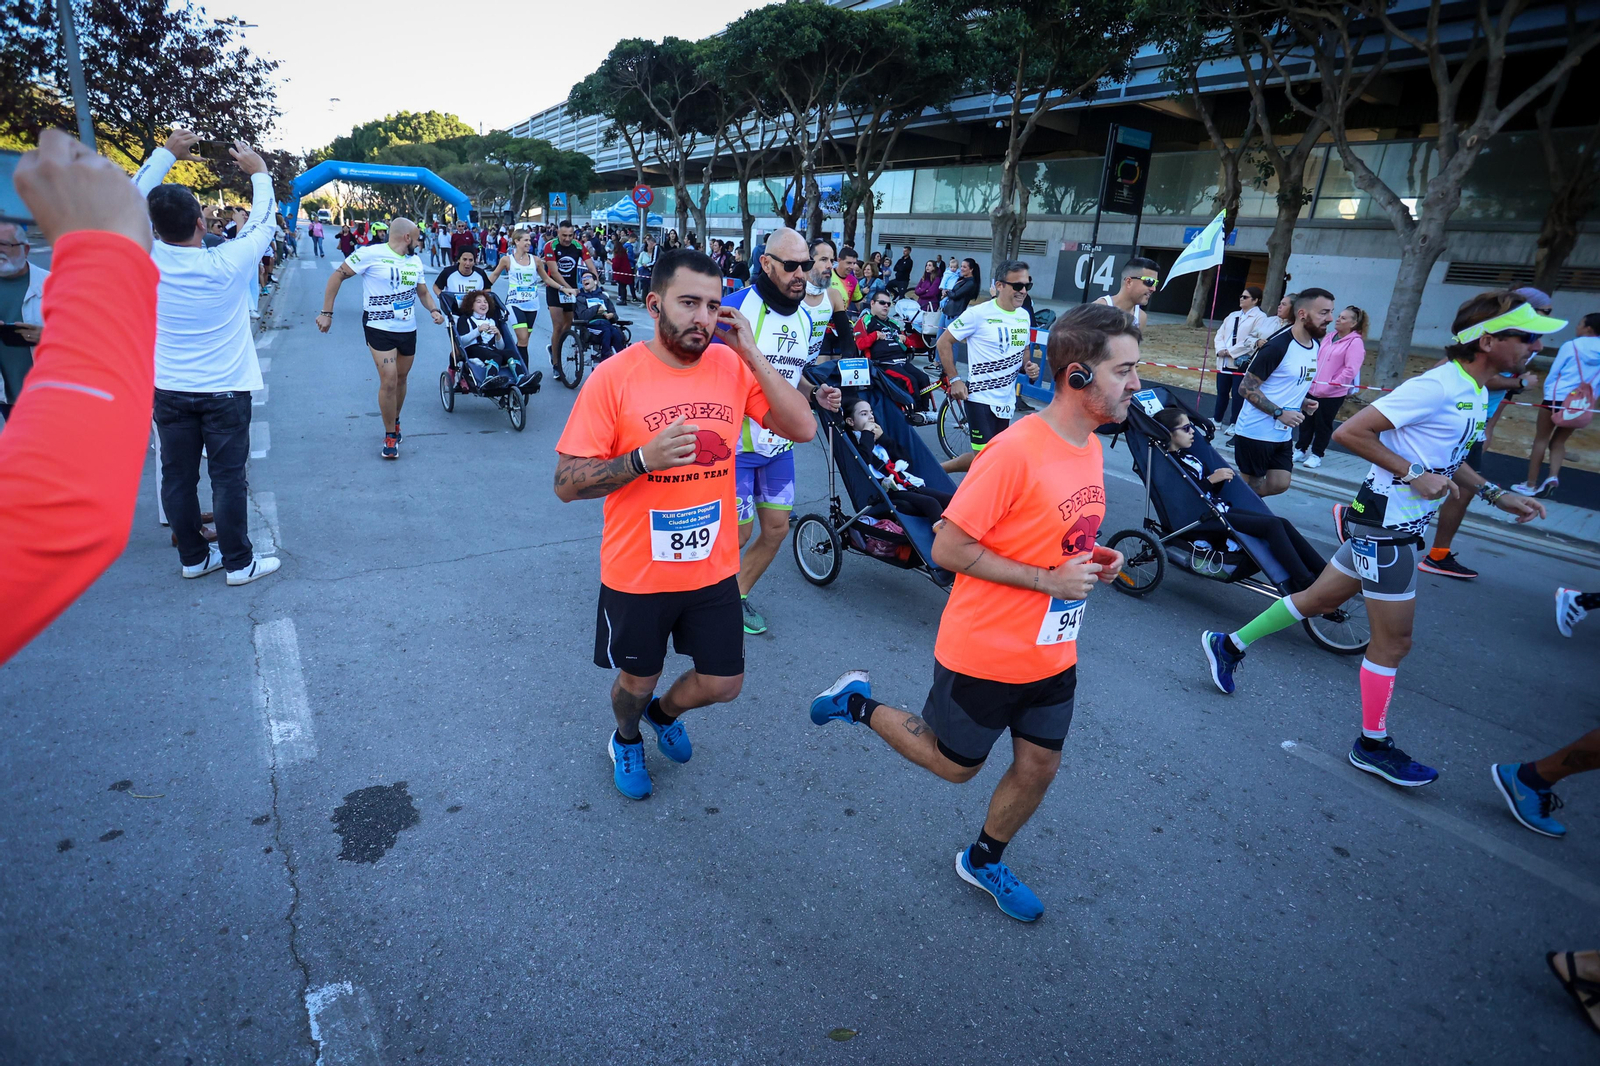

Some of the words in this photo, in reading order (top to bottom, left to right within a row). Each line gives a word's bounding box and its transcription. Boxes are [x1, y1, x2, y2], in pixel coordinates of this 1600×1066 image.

[1081, 243, 1102, 252] Tribna
[1074, 253, 1116, 291] 04
[403, 308, 412, 317] 57
[763, 354, 806, 367] ETE-RUNNERS
[776, 368, 794, 379] EREZ
[853, 369, 859, 379] 8
[1147, 400, 1153, 409] 5
[643, 403, 733, 432] PEREZA
[647, 472, 700, 483] RUNNING
[703, 468, 729, 479] TEAM
[676, 510, 697, 518] Carrera
[697, 505, 716, 514] Popular
[670, 527, 710, 551] 849
[1057, 606, 1084, 631] 941
